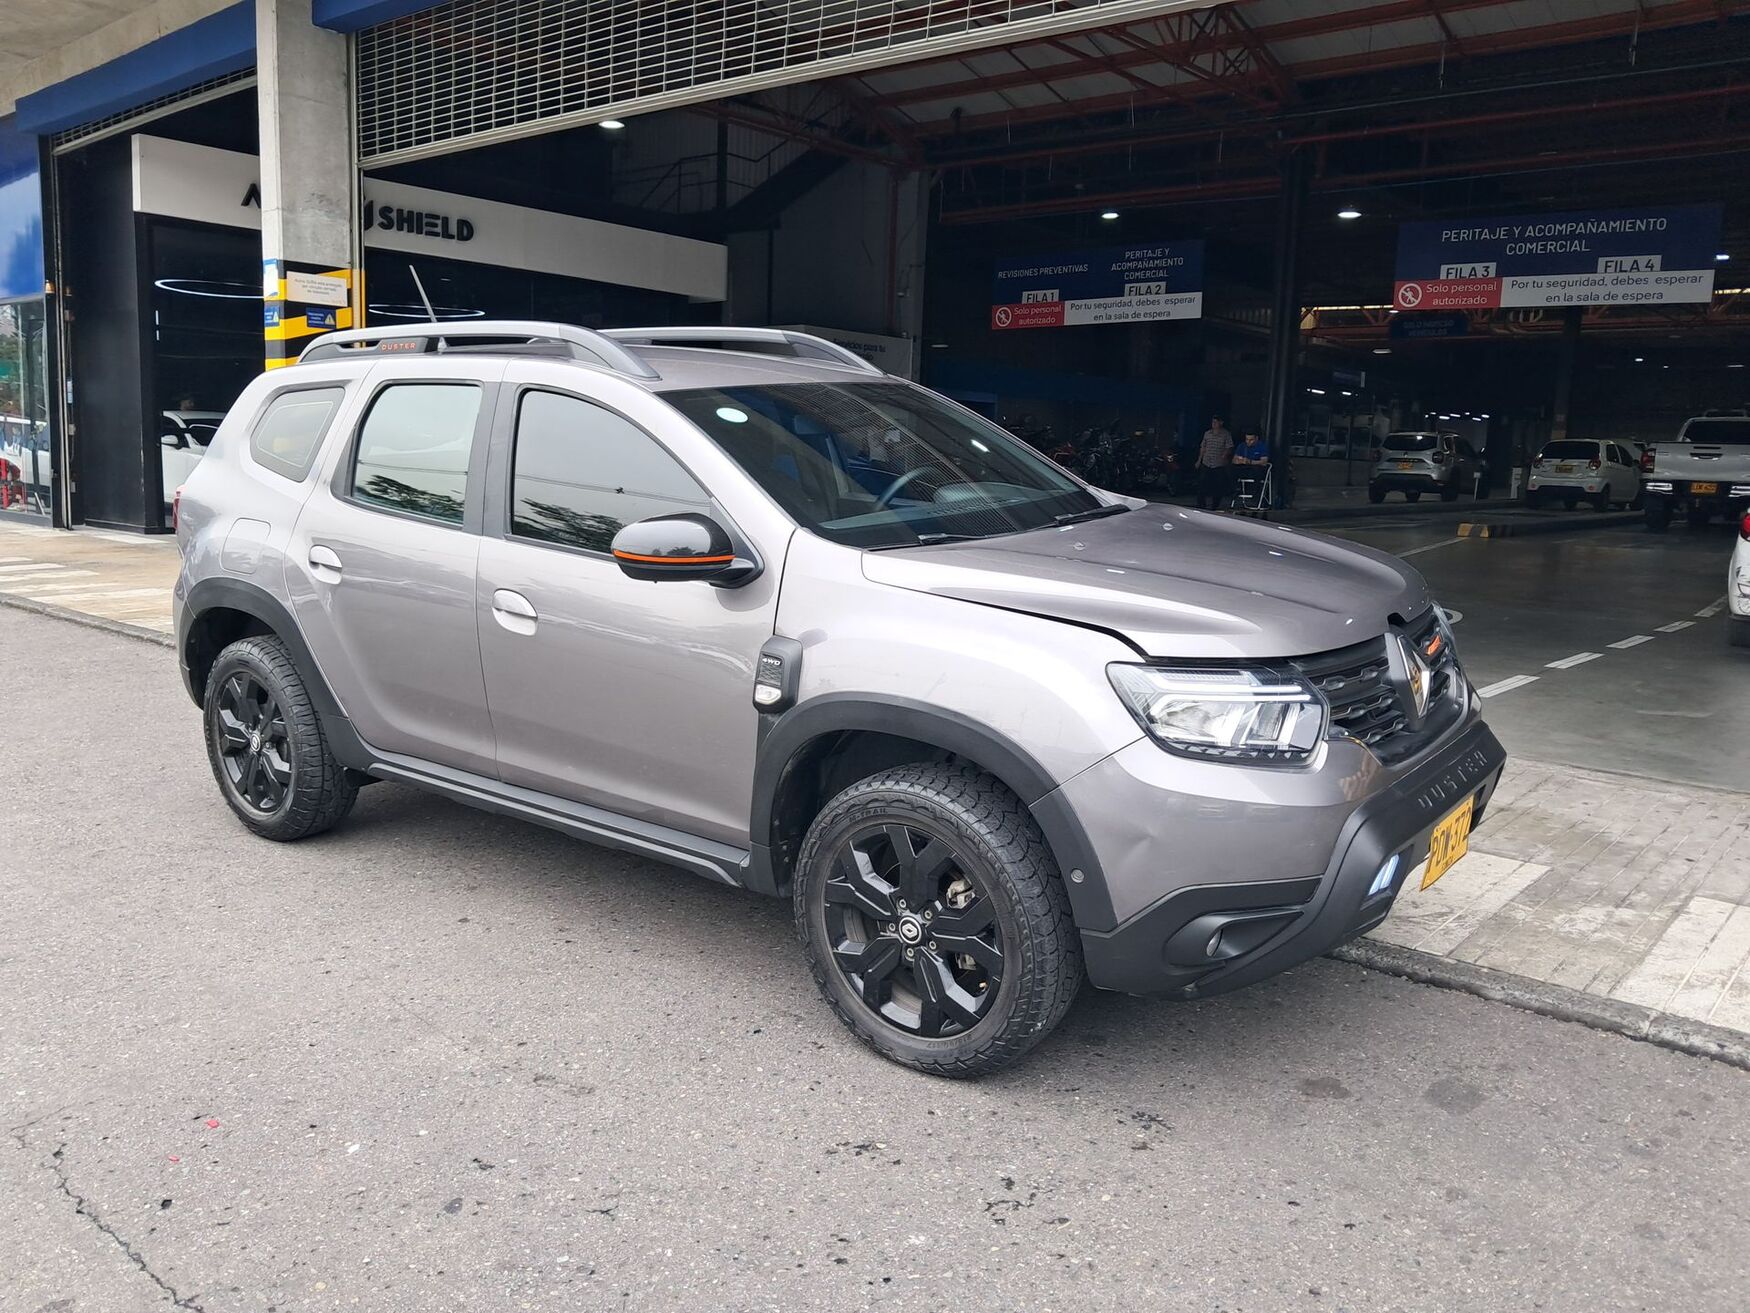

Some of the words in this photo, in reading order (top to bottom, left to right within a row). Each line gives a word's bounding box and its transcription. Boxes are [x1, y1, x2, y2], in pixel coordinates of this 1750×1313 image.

[378, 205, 474, 242] SHIELD
[1441, 226, 1510, 243] PERITAJE
[1512, 225, 1522, 238] Y
[1524, 217, 1667, 238] ACOMPAÑAMIENTO
[1125, 248, 1163, 259] PERITAJE
[1163, 247, 1170, 256] Y
[1505, 239, 1591, 256] COMERCIAL
[998, 265, 1038, 279] REVISIONES
[1039, 263, 1089, 276] PREVENTIVAS
[1110, 257, 1184, 272] ACOMPAÑAMIENTO
[1604, 259, 1640, 273] FILA
[1645, 258, 1655, 272] 4
[1124, 269, 1169, 281] COMERCIAL
[1446, 266, 1477, 279] FILA
[1481, 265, 1490, 278] 3
[1425, 283, 1449, 293] Solo
[1450, 281, 1497, 294] personal
[1511, 279, 1530, 289] Por
[1532, 280, 1543, 288] tu
[1610, 275, 1649, 286] debes
[1655, 274, 1704, 286] esperar
[1128, 285, 1151, 297] FILA
[1154, 284, 1161, 295] 2
[1545, 294, 1560, 303] en
[1563, 292, 1573, 302] la
[1576, 291, 1600, 302] sala
[1603, 291, 1619, 301] de
[1621, 291, 1664, 302] espera
[1026, 293, 1047, 304] FILA
[1070, 302, 1083, 311] Por
[1084, 301, 1092, 310] tu
[1135, 296, 1161, 307] debes
[1164, 296, 1195, 307] esperar
[1432, 294, 1487, 306] autorizado
[1013, 307, 1030, 316] Solo
[1031, 304, 1062, 316] personal
[1093, 313, 1104, 321] en
[1105, 312, 1112, 321] la
[1113, 312, 1129, 320] sala
[1130, 311, 1141, 319] de
[1142, 310, 1171, 320] espera
[1018, 316, 1056, 326] autorizado
[381, 342, 416, 351] DUSTER
[762, 657, 781, 666] 4WD
